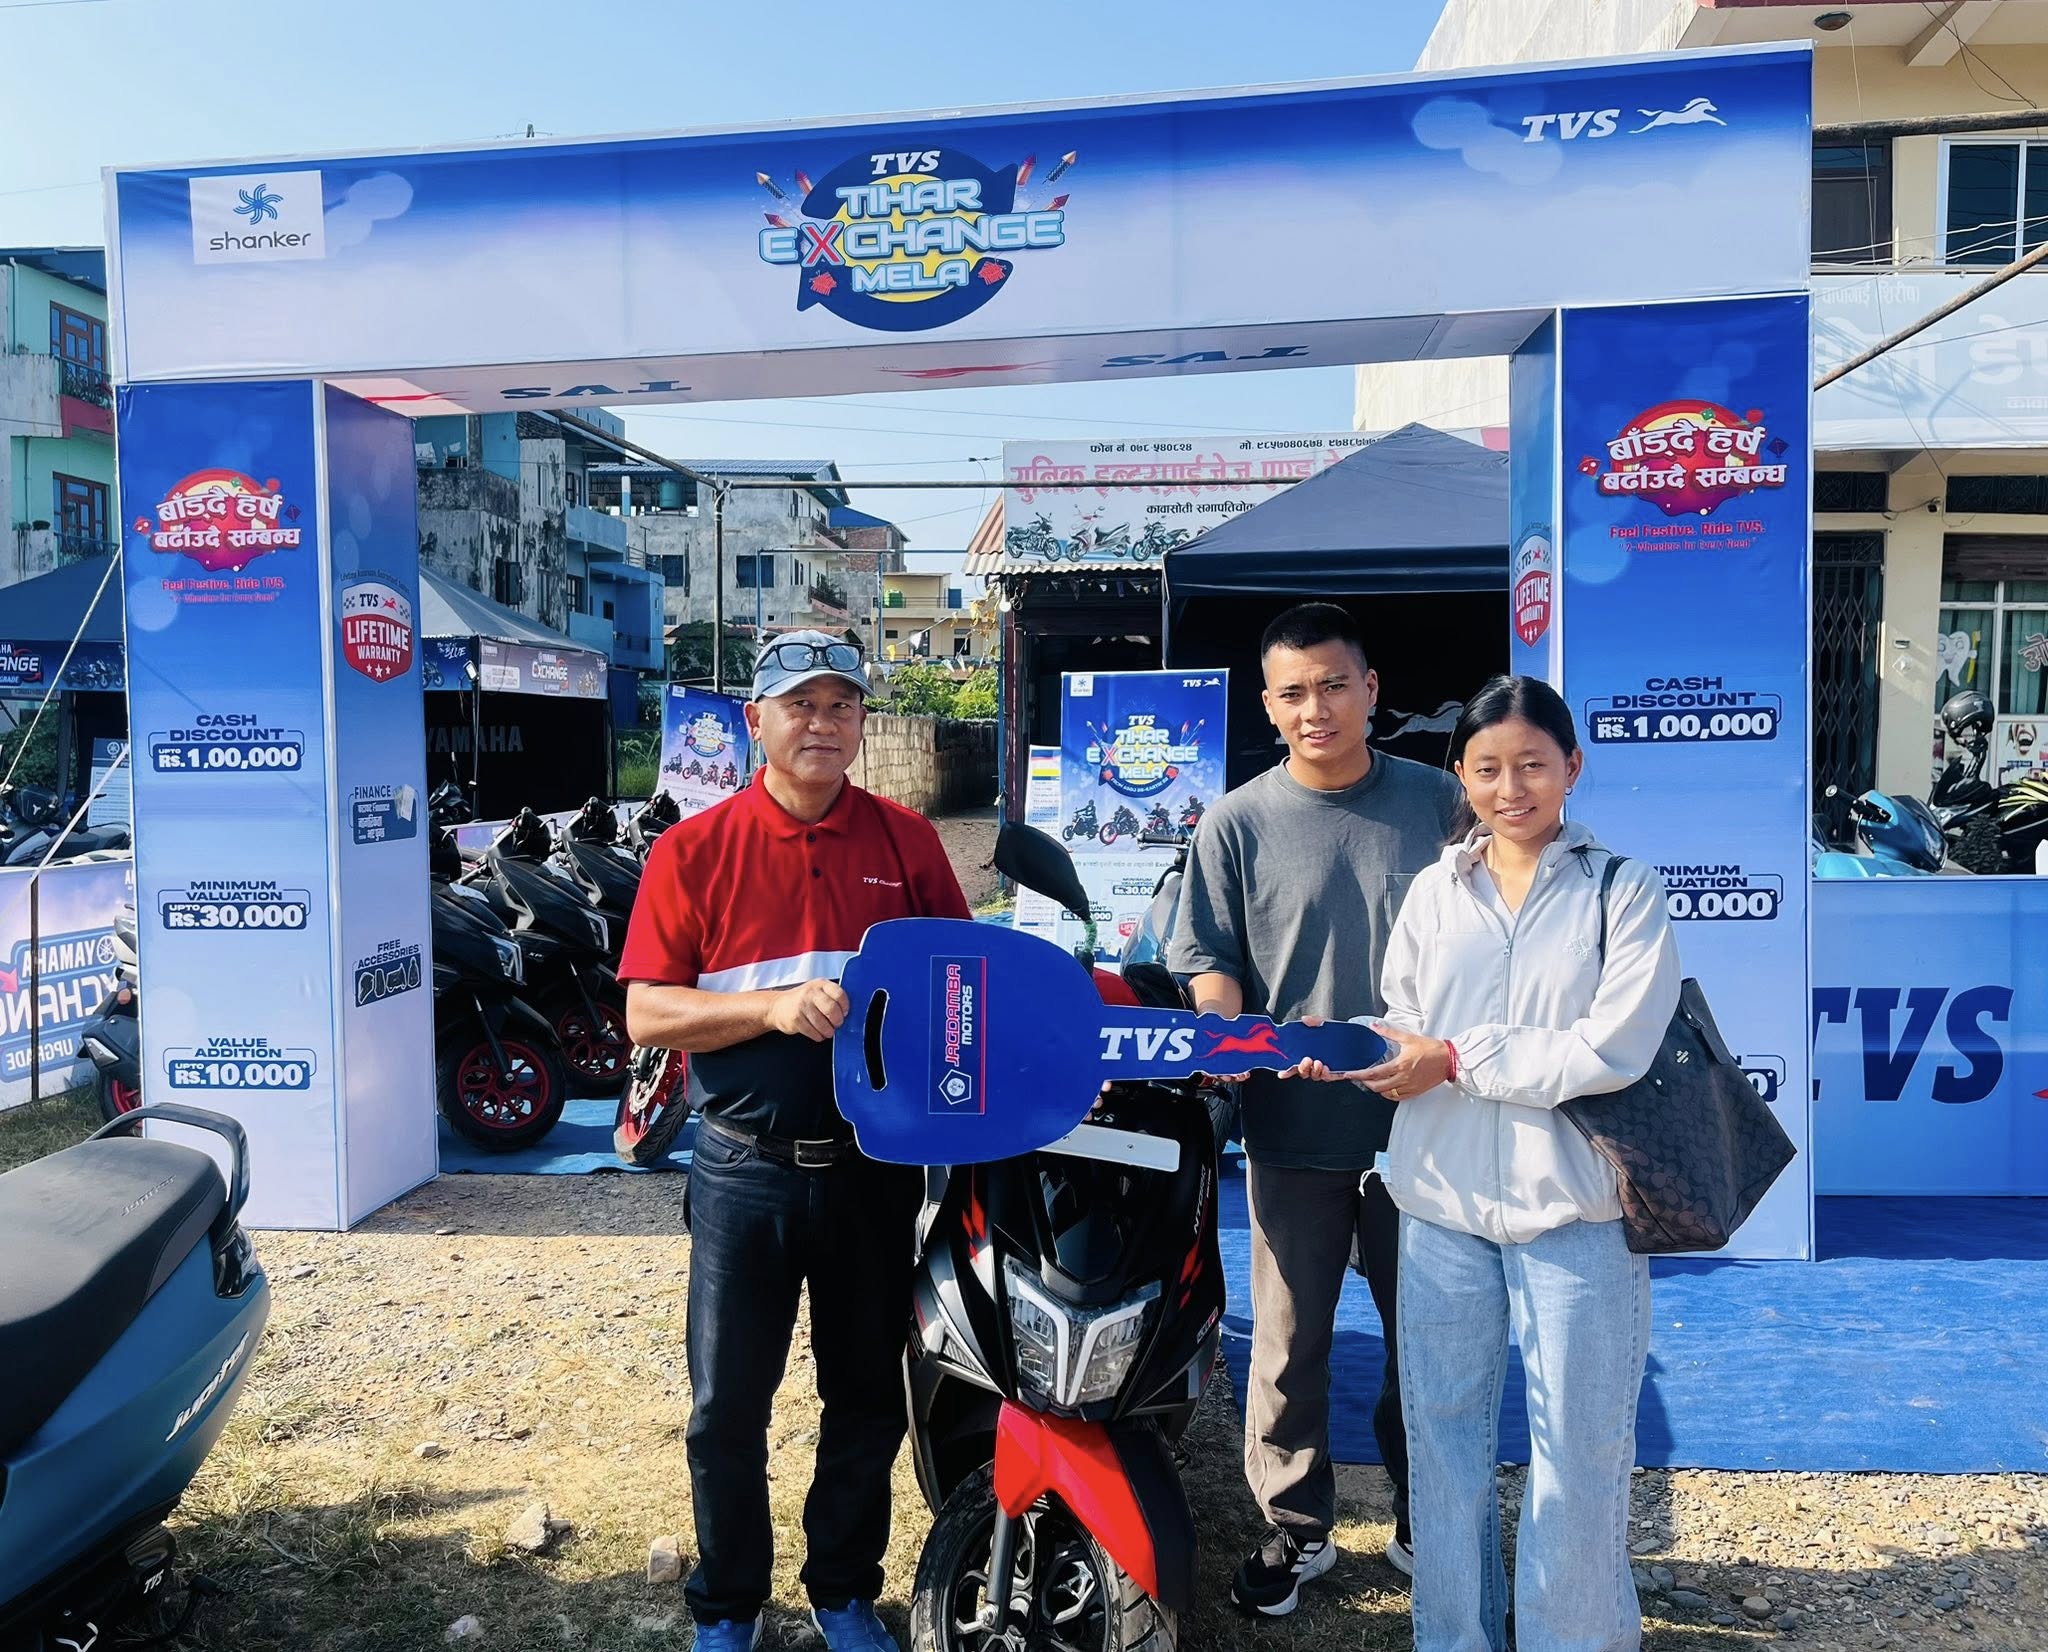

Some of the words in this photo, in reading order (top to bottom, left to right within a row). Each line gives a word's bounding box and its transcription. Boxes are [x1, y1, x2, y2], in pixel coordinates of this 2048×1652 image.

[1522, 109, 1620, 143] TVS
[871, 150, 941, 175] TVS
[836, 179, 983, 218] TIHAR
[209, 230, 312, 251] shanker
[759, 210, 1064, 268] EXCHANGE
[852, 259, 969, 294] MELA
[1090, 443, 1113, 453] फोन
[1610, 526, 1638, 538] Feel
[1701, 523, 1733, 534] Ride
[162, 579, 185, 591] Feel
[235, 577, 260, 589] Ride
[359, 594, 379, 608] TVS
[1516, 576, 1549, 613] LIFETIME
[347, 621, 410, 652] LIFETIME
[357, 646, 400, 664] WARRANTY
[1182, 679, 1202, 688] TVS
[1646, 676, 1722, 691] CASH
[1612, 692, 1756, 709] DISCOUNT
[196, 714, 257, 727] CASH
[1128, 715, 1156, 726] TVS
[169, 728, 284, 742] DISCOUNT
[426, 726, 524, 753] YAMAHA
[1115, 728, 1170, 744] TIHAR
[1086, 746, 1199, 766] EXCHANGE
[1118, 766, 1163, 779] MELA
[354, 785, 391, 800] FINANCE
[1654, 865, 1740, 876] NIMUM
[190, 881, 276, 890] MINIMUM
[1663, 877, 1748, 888] UATION
[186, 892, 282, 901] VALUATION
[377, 939, 401, 953] FREE
[358, 944, 420, 969] ACCESSORIES
[945, 964, 961, 1067] JAGDAMBA
[962, 985, 973, 1045] MOTORS
[208, 1038, 268, 1048] VALUE
[1100, 1026, 1196, 1062] TVS
[1812, 985, 2014, 1104] TVS
[194, 1049, 282, 1058] ADDITION
[144, 1568, 164, 1594] TVS
